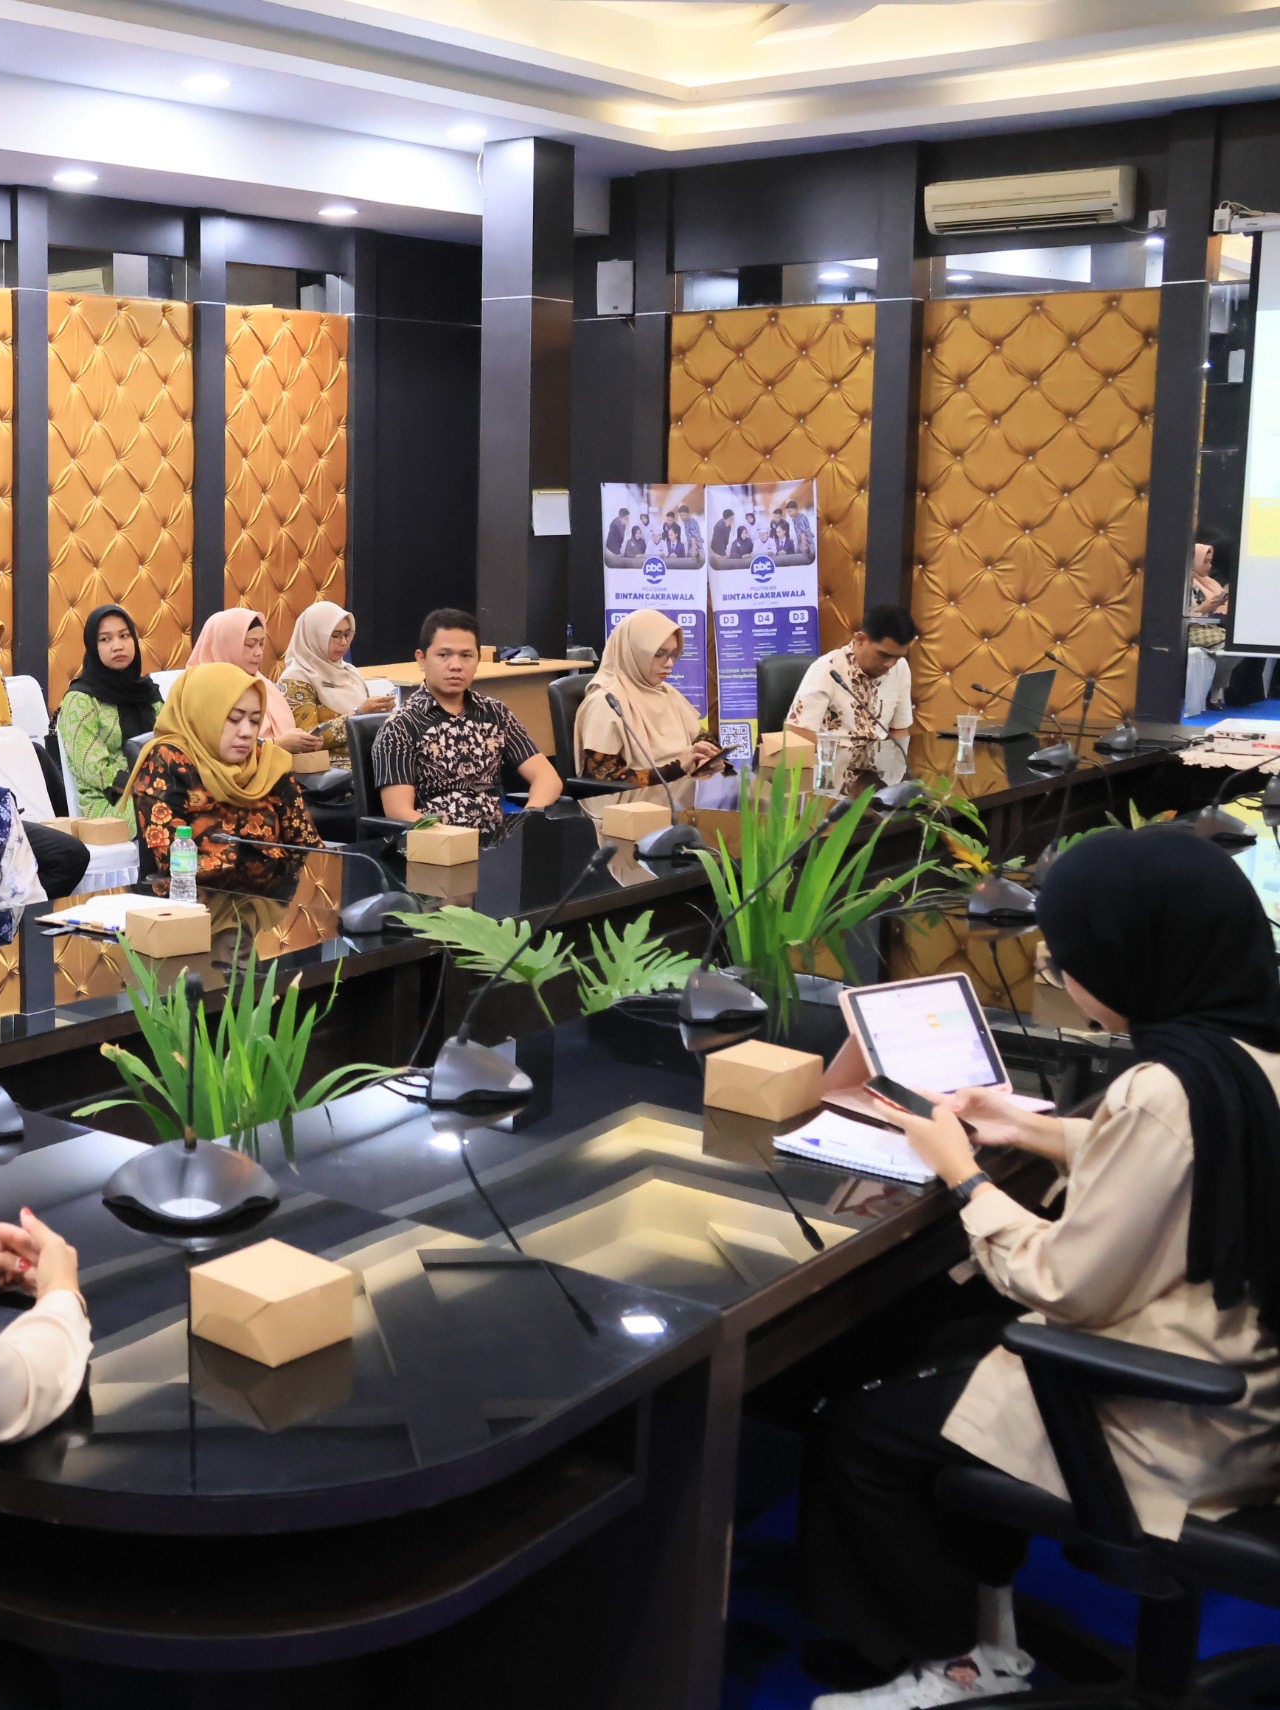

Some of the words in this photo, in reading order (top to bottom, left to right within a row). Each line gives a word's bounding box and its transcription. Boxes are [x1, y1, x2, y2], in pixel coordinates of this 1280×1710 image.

[615, 592, 644, 600] BINTAN
[645, 593, 695, 601] CAKRAWALA
[722, 592, 752, 601] BINTAN
[753, 589, 806, 599] CAKRAWALA
[681, 616, 693, 624] D3
[723, 616, 735, 624] D3
[757, 614, 770, 623] D4
[792, 612, 805, 621] D3
